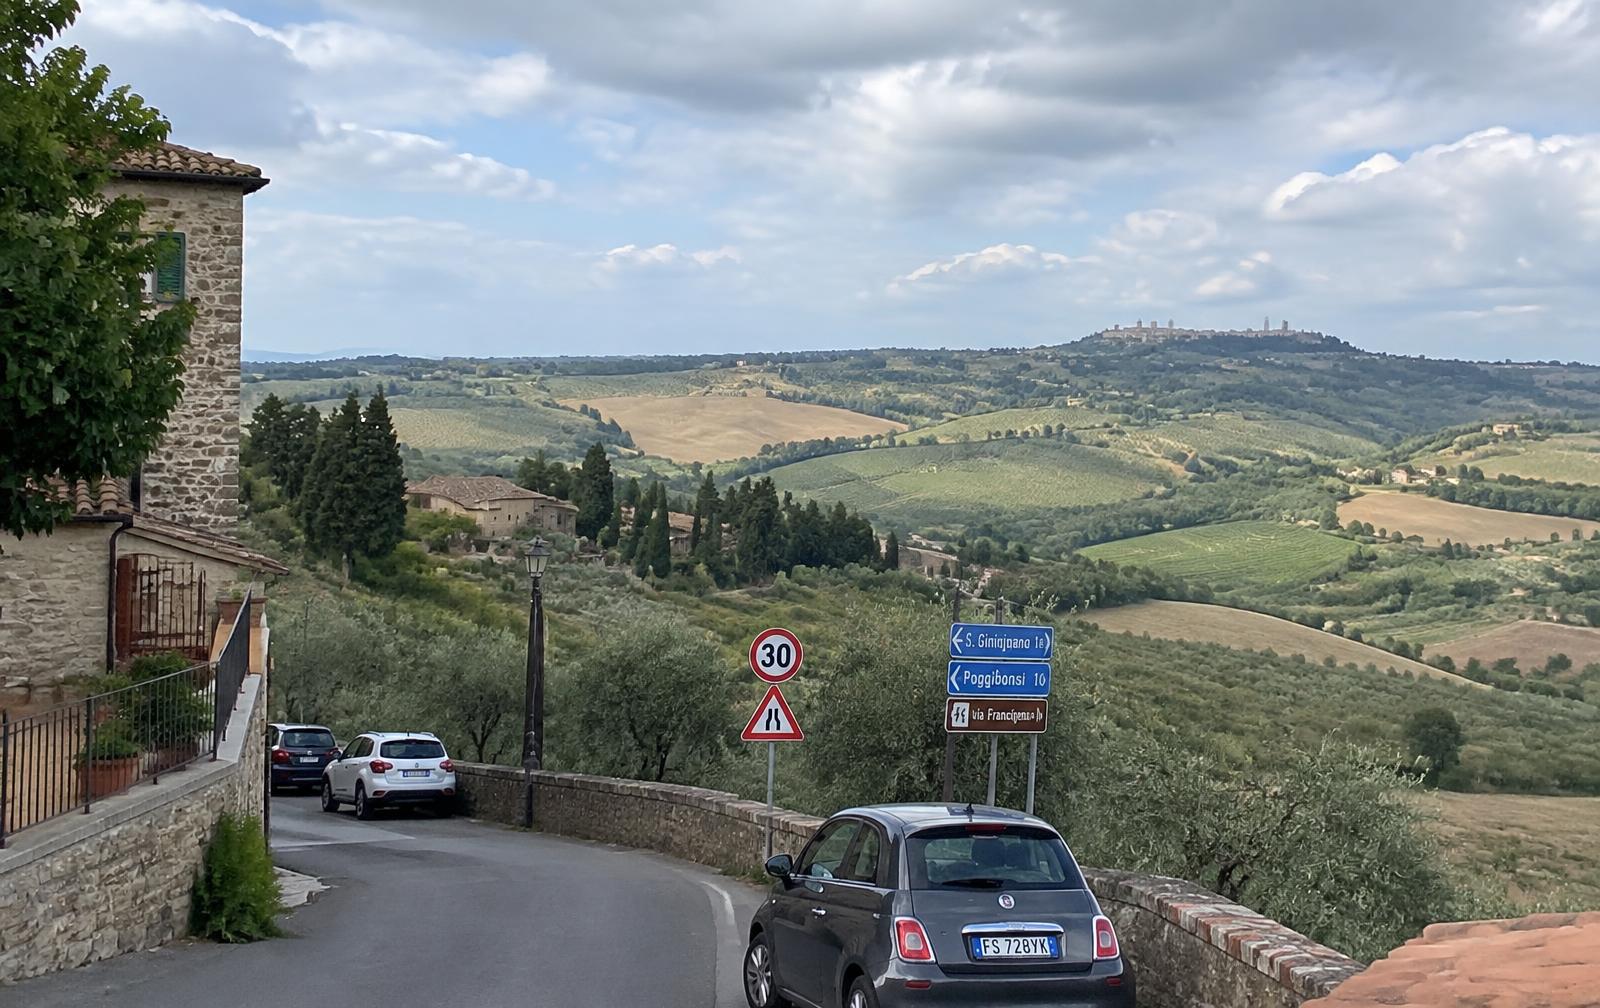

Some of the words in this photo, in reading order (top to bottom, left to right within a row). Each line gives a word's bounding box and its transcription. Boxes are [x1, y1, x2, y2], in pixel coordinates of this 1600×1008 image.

[965, 632, 975, 648] S.
[761, 643, 791, 668] 30
[963, 669, 1026, 689] Poggibonsi
[982, 939, 1000, 955] FS
[1004, 938, 1048, 955] 728YK
